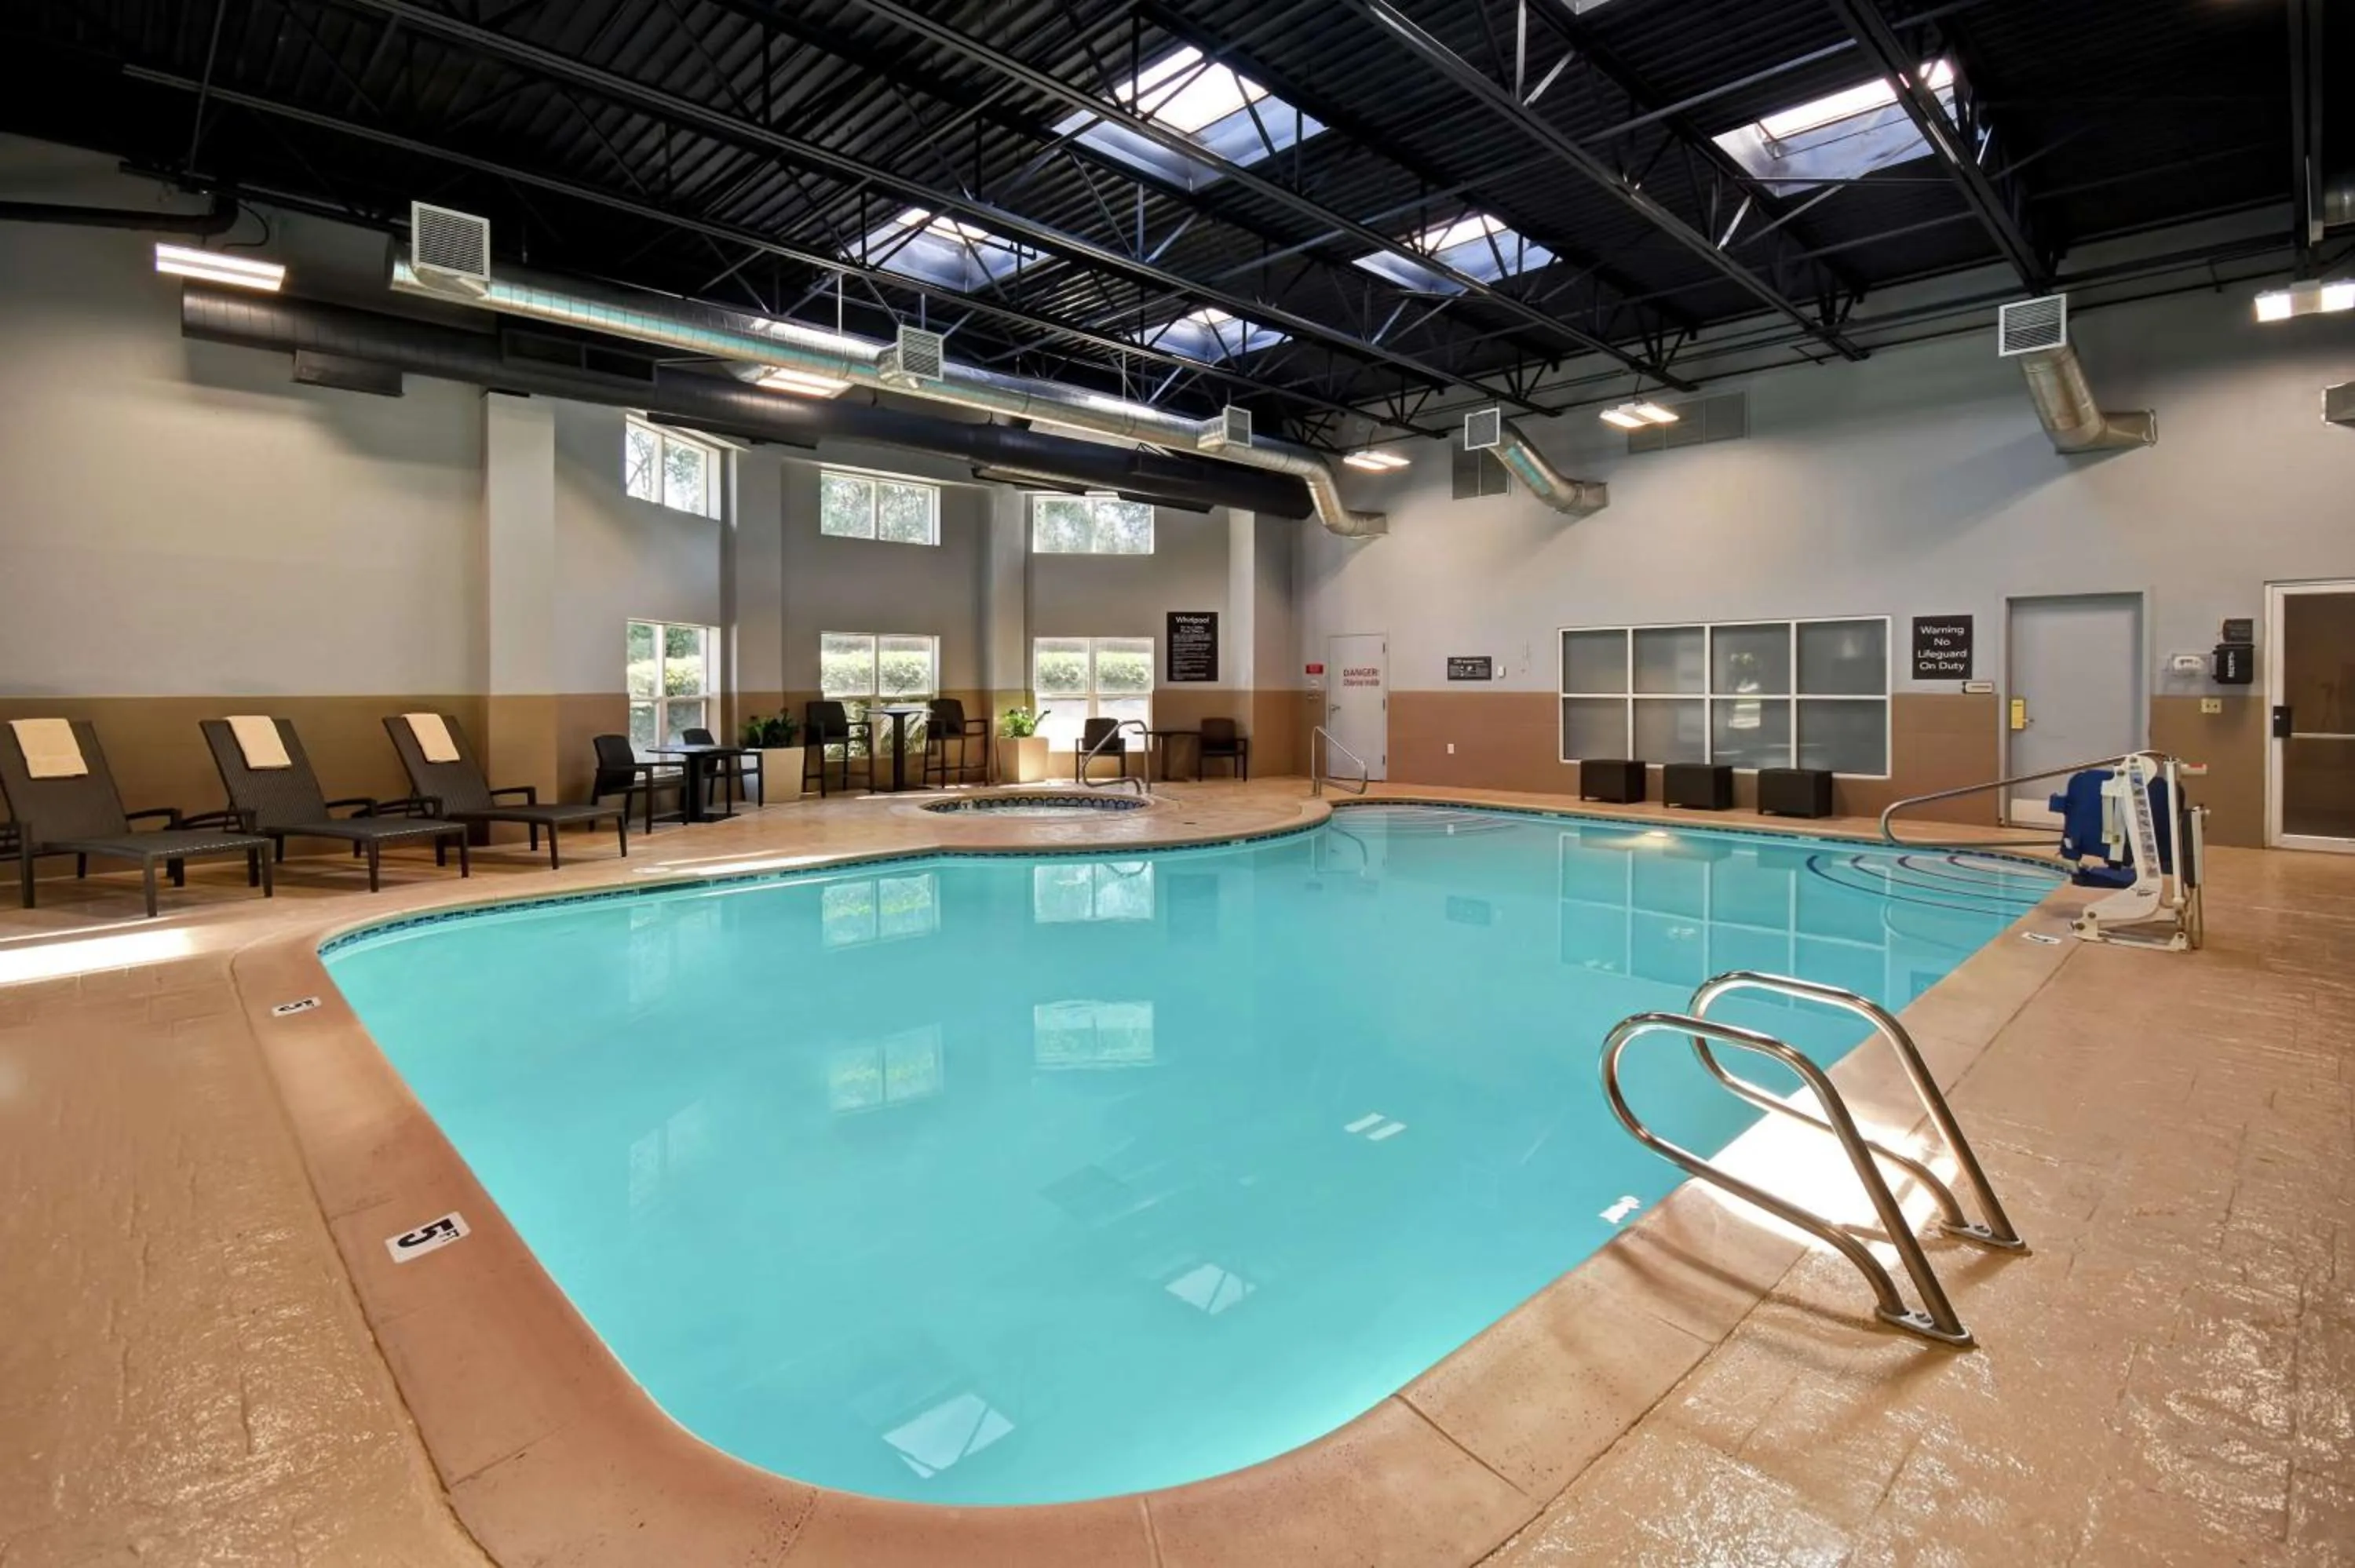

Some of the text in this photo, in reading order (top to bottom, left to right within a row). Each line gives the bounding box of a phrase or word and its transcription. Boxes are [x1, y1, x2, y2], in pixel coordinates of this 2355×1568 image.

[1920, 625, 1965, 636] Warning
[1918, 649, 1967, 659] Lifeguard
[1919, 662, 1965, 672] On Duty
[397, 1218, 454, 1248] 5
